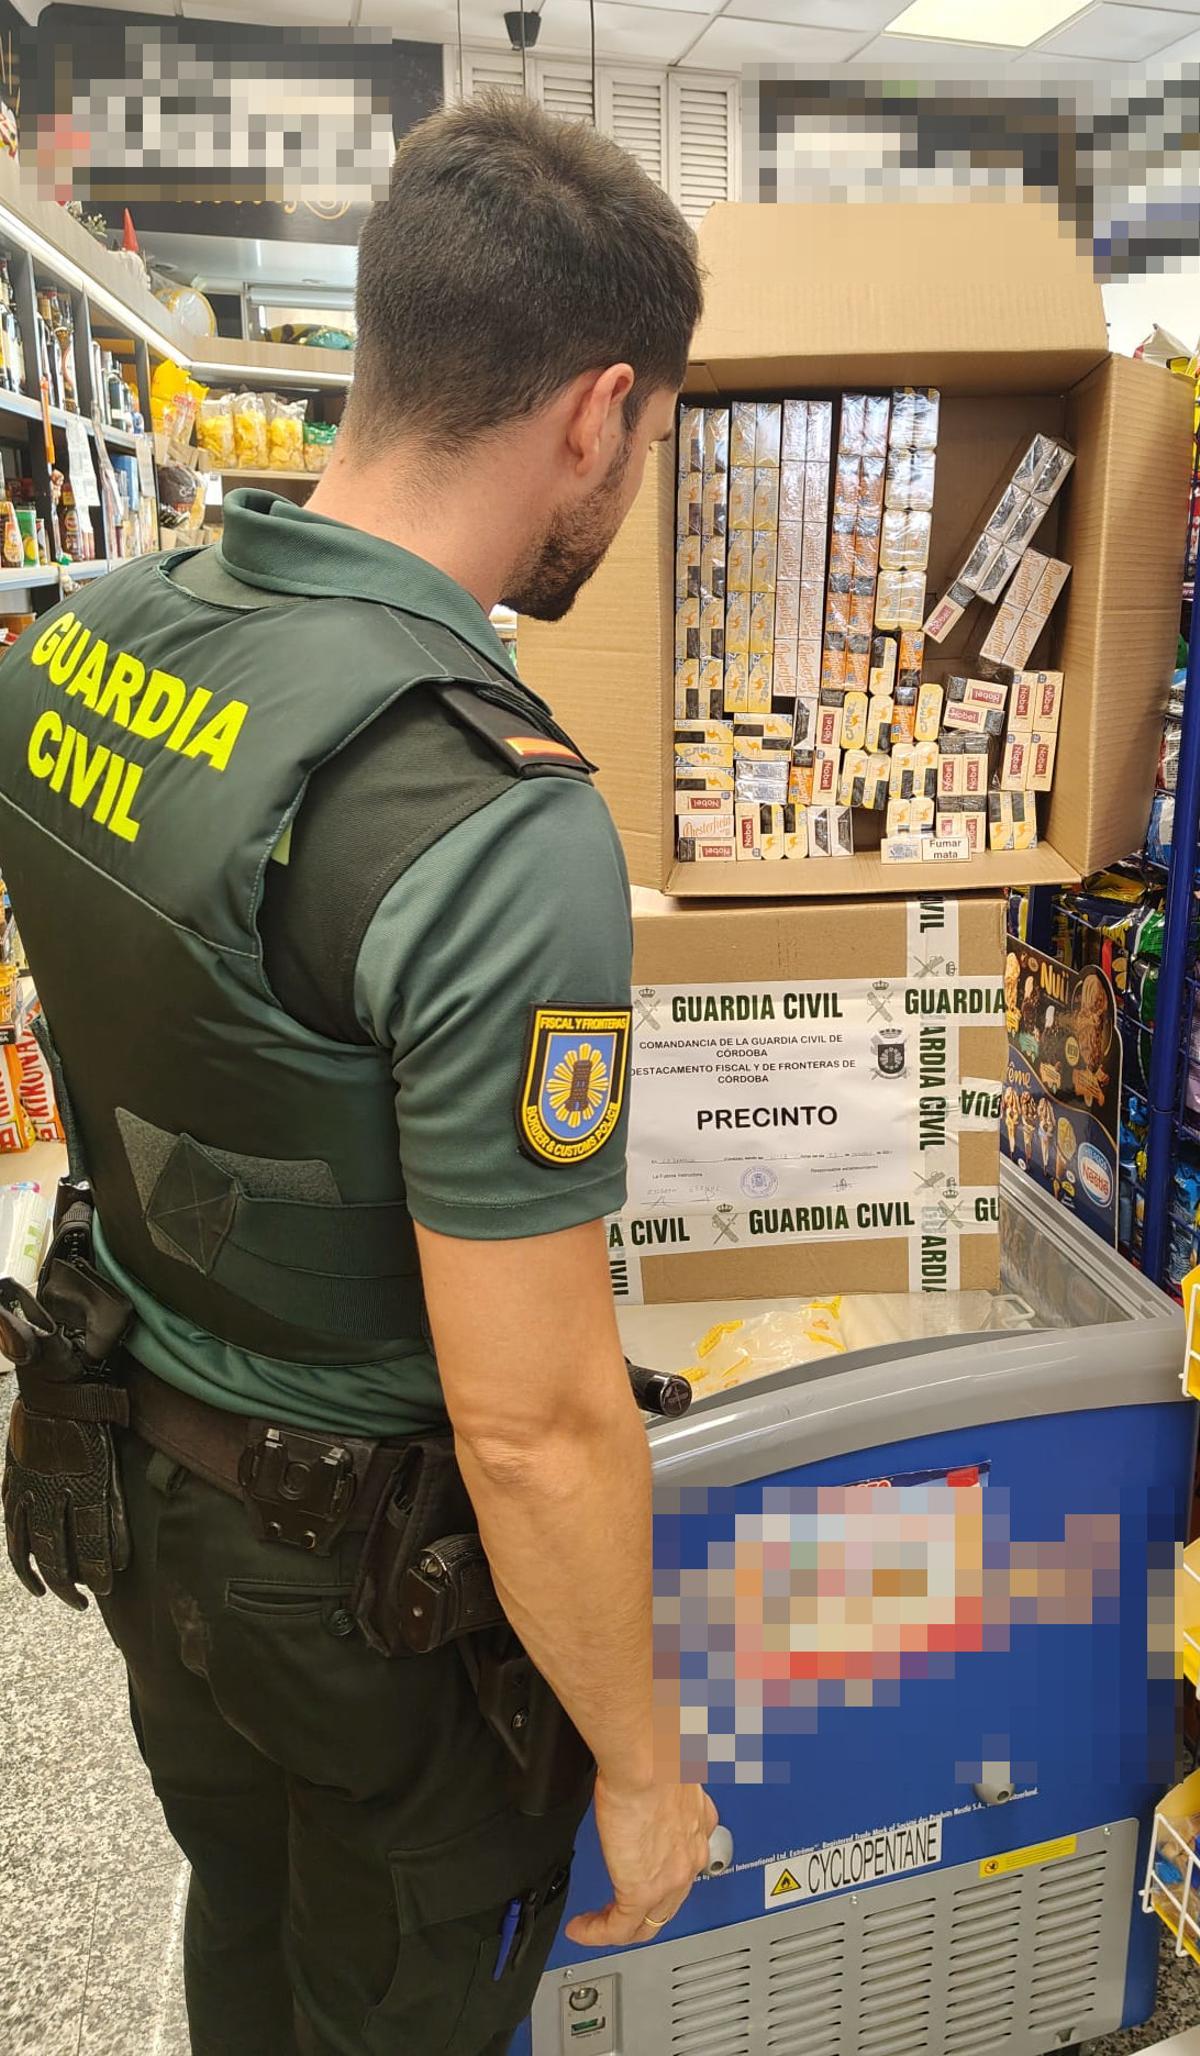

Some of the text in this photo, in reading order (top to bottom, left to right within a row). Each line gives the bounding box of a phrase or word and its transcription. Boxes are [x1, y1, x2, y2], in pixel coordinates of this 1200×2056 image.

[31, 611, 249, 772] GUARDIA
[1019, 686, 1029, 713] Nobel
[823, 715, 833, 743] Nobel
[27, 710, 143, 843] CIVIL
[822, 762, 832, 788] Nobel
[943, 764, 953, 791] Nobel
[968, 764, 978, 791] Nobel
[692, 799, 720, 807] Nobel
[743, 820, 753, 847] Nobel
[929, 839, 961, 848] Fumar
[934, 851, 958, 859] mata
[919, 895, 944, 933] IVIL
[672, 992, 843, 1022] GUARDIA CIVIL
[905, 988, 1007, 1014] GUARDIA
[540, 1017, 574, 1029] FISCAL
[574, 1018, 582, 1028] Y
[639, 1034, 843, 1050] COMANDANCIA DE LA GUARDIA CIVIL DE
[631, 1059, 856, 1077] DESTACAMENTO FISCAL Y DE FRONTERAS DE
[526, 1102, 619, 1157] BORDER & CUSTOMS POLICE
[697, 1105, 838, 1131] PRECINTO
[919, 1096, 946, 1150] CIVIL
[631, 1216, 690, 1245] CIVIL
[749, 1201, 915, 1234] GUARDIA CIVIL
[735, 1855, 776, 1872] International
[808, 1822, 937, 1894] CYCLOPENTANE
